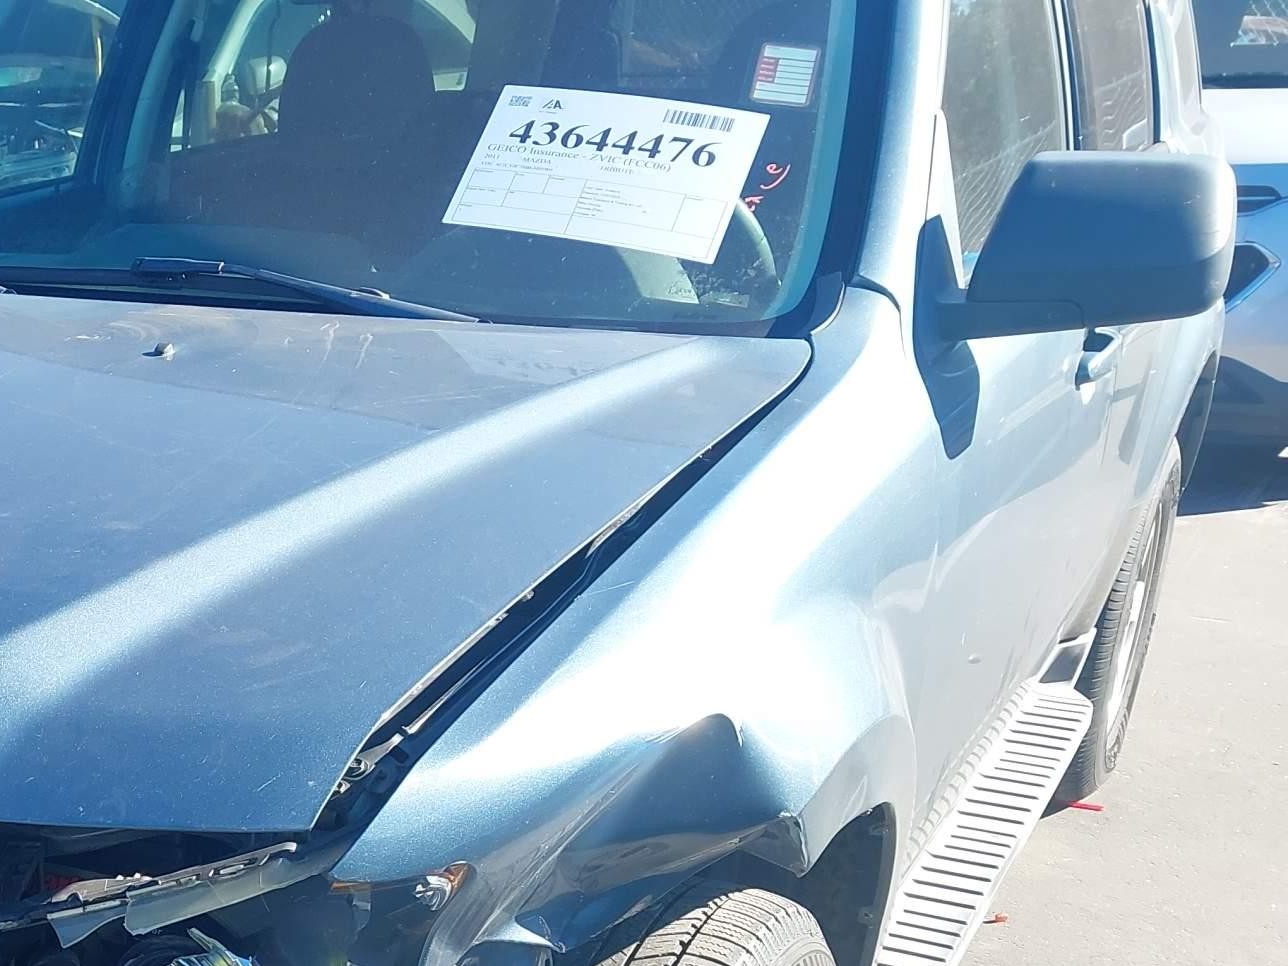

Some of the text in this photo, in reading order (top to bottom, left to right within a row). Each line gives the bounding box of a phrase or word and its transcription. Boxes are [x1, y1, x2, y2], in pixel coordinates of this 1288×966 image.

[487, 143, 527, 153] GEICO
[529, 146, 580, 160] Insurance
[590, 154, 623, 165] ZVIC
[509, 119, 723, 168] 43644476
[523, 157, 552, 165] MAZDA
